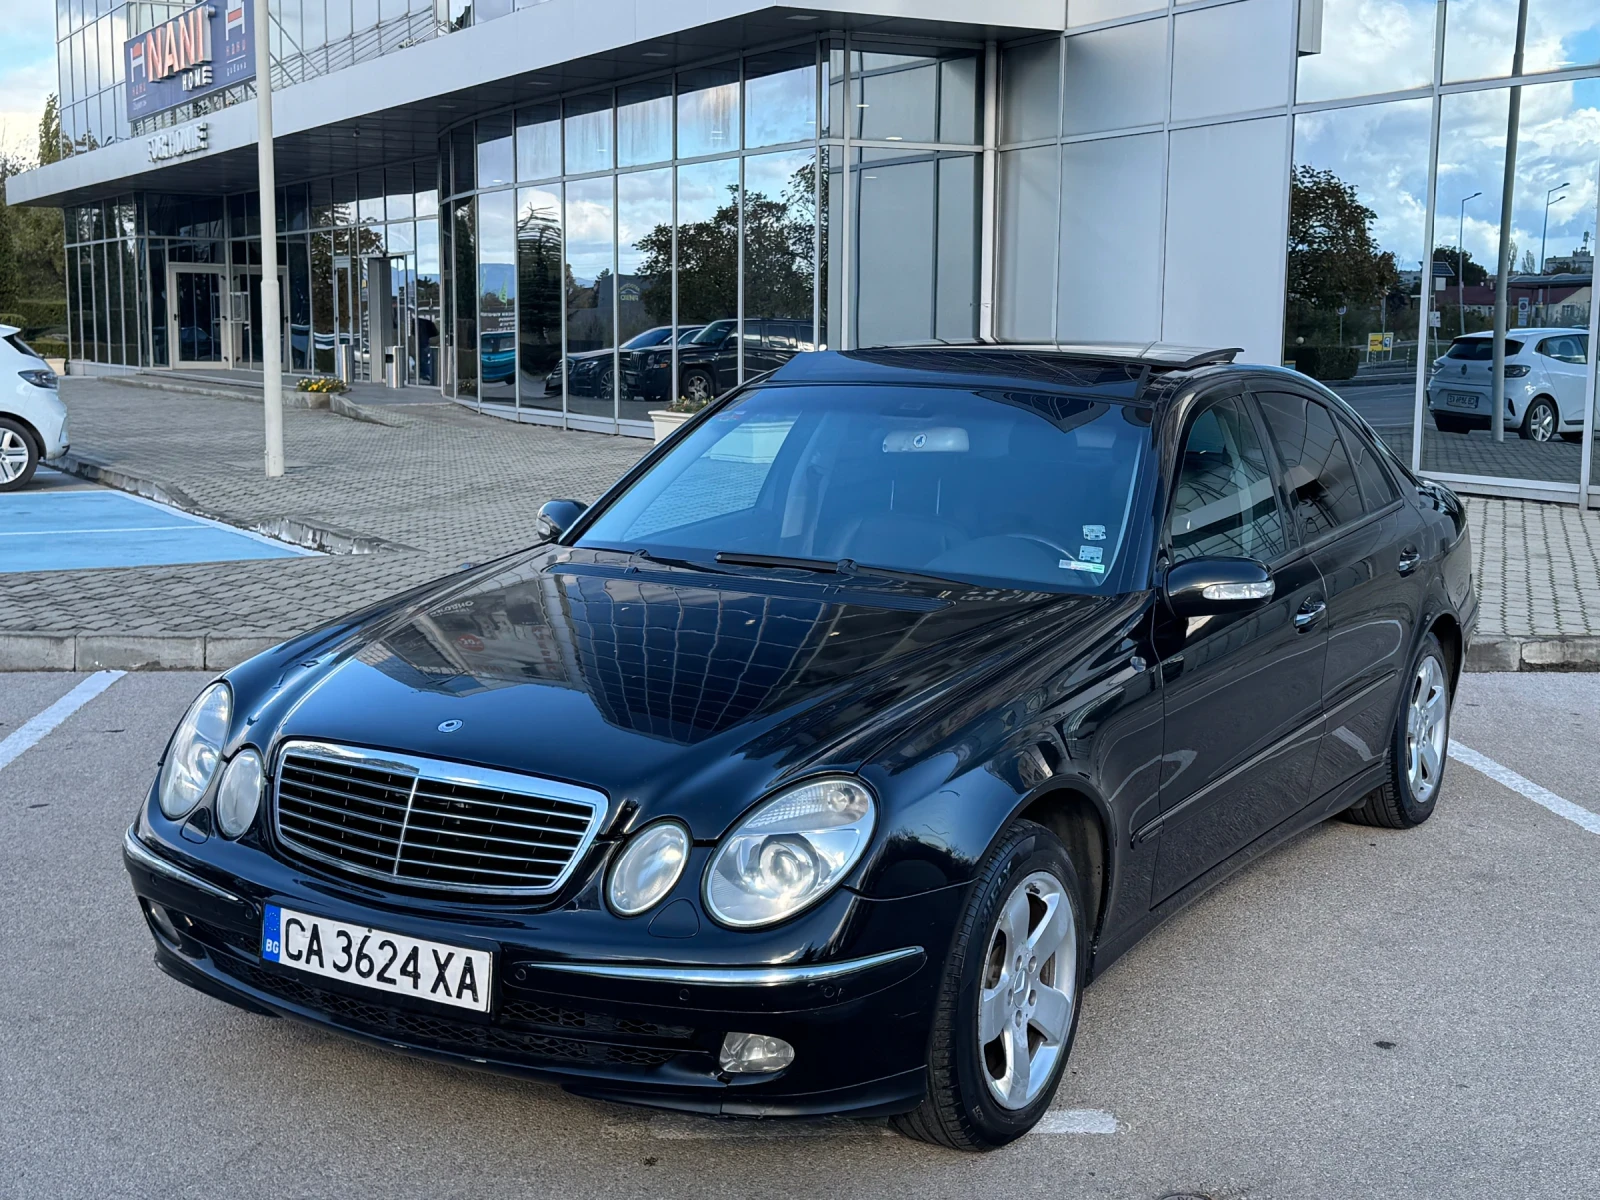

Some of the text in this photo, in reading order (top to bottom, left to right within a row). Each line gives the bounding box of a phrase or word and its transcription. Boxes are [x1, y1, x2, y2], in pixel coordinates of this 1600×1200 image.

[146, 5, 207, 83] NANI
[182, 65, 212, 92] HOME
[265, 938, 280, 955] BG
